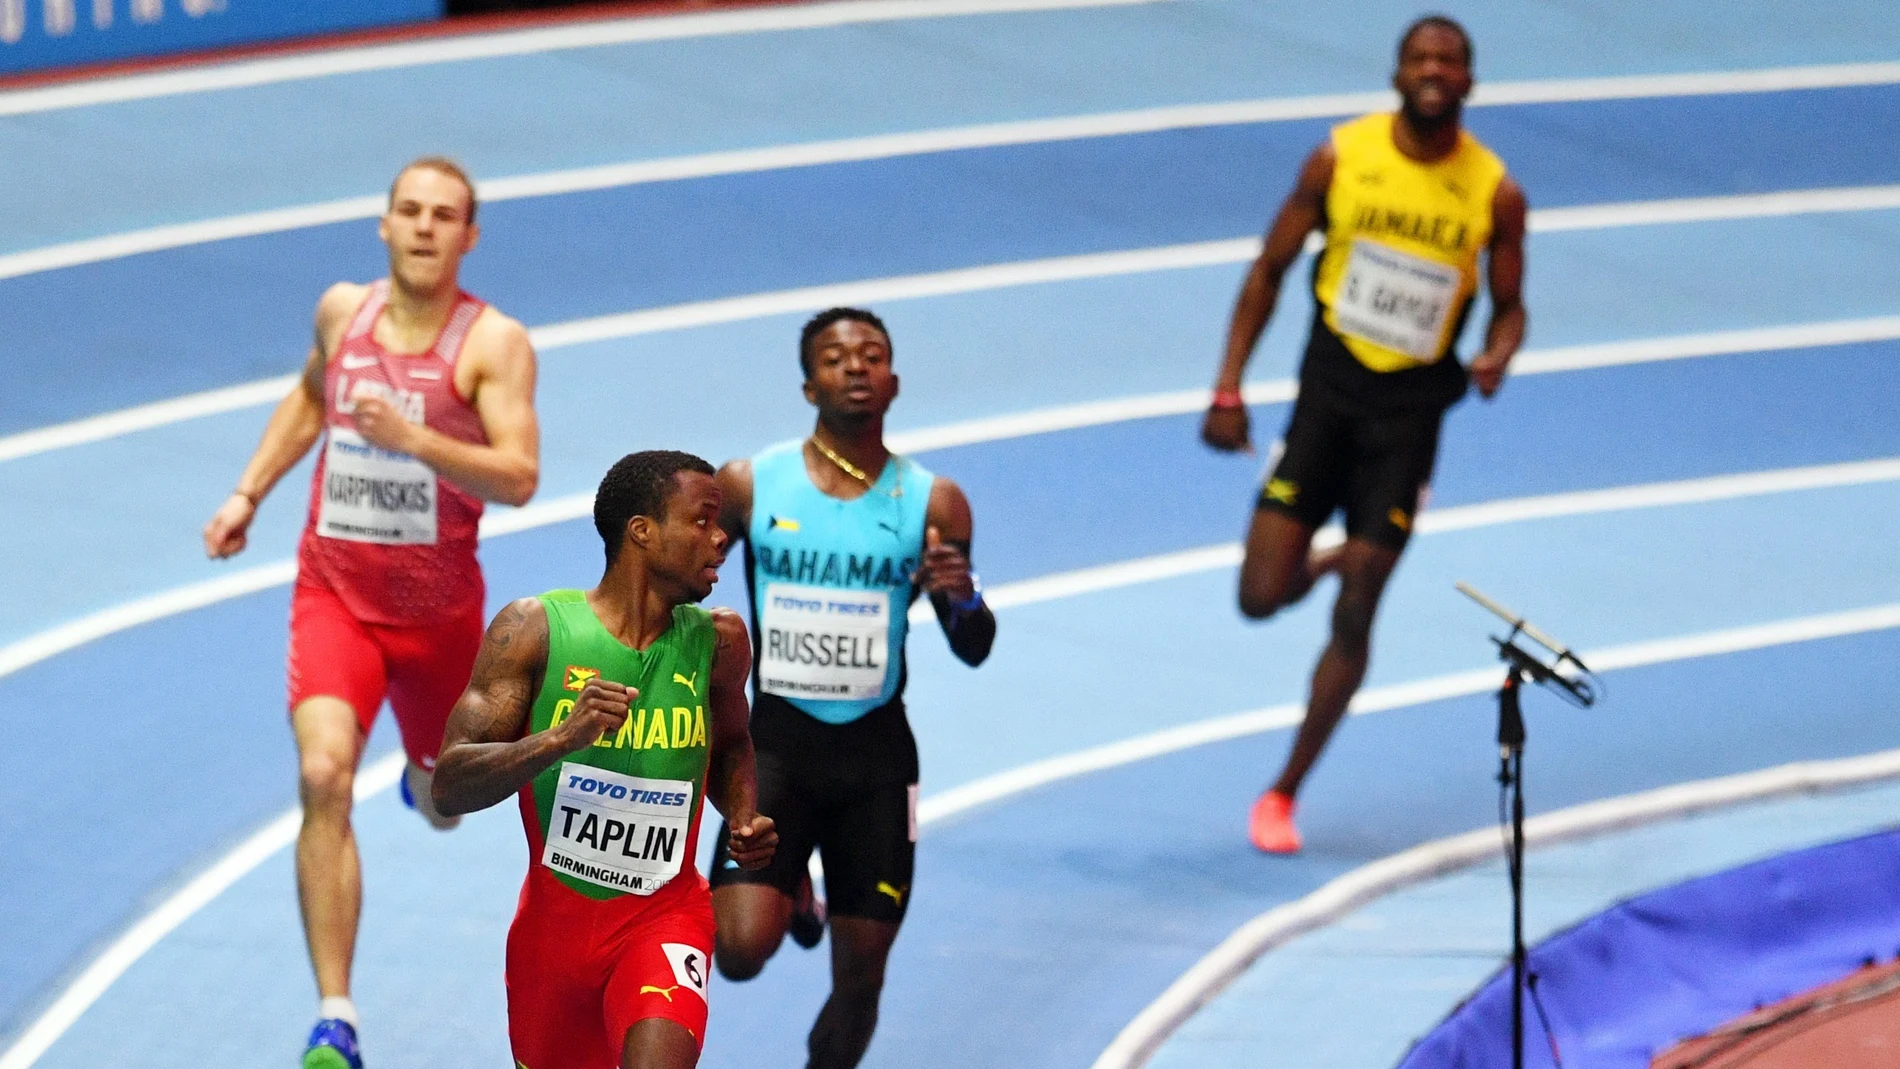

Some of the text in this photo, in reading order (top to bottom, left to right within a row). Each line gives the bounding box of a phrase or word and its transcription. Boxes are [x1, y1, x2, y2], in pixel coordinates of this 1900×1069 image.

[758, 547, 916, 587] BAHAMAS
[774, 596, 822, 612] TOYO
[768, 628, 879, 669] RUSSELL
[551, 698, 706, 749] GNADA
[568, 775, 688, 807] TOYO TIRES
[560, 804, 678, 863] TAPLIN
[550, 852, 670, 891] BIRMINGHAM 20
[684, 953, 703, 989] 6
